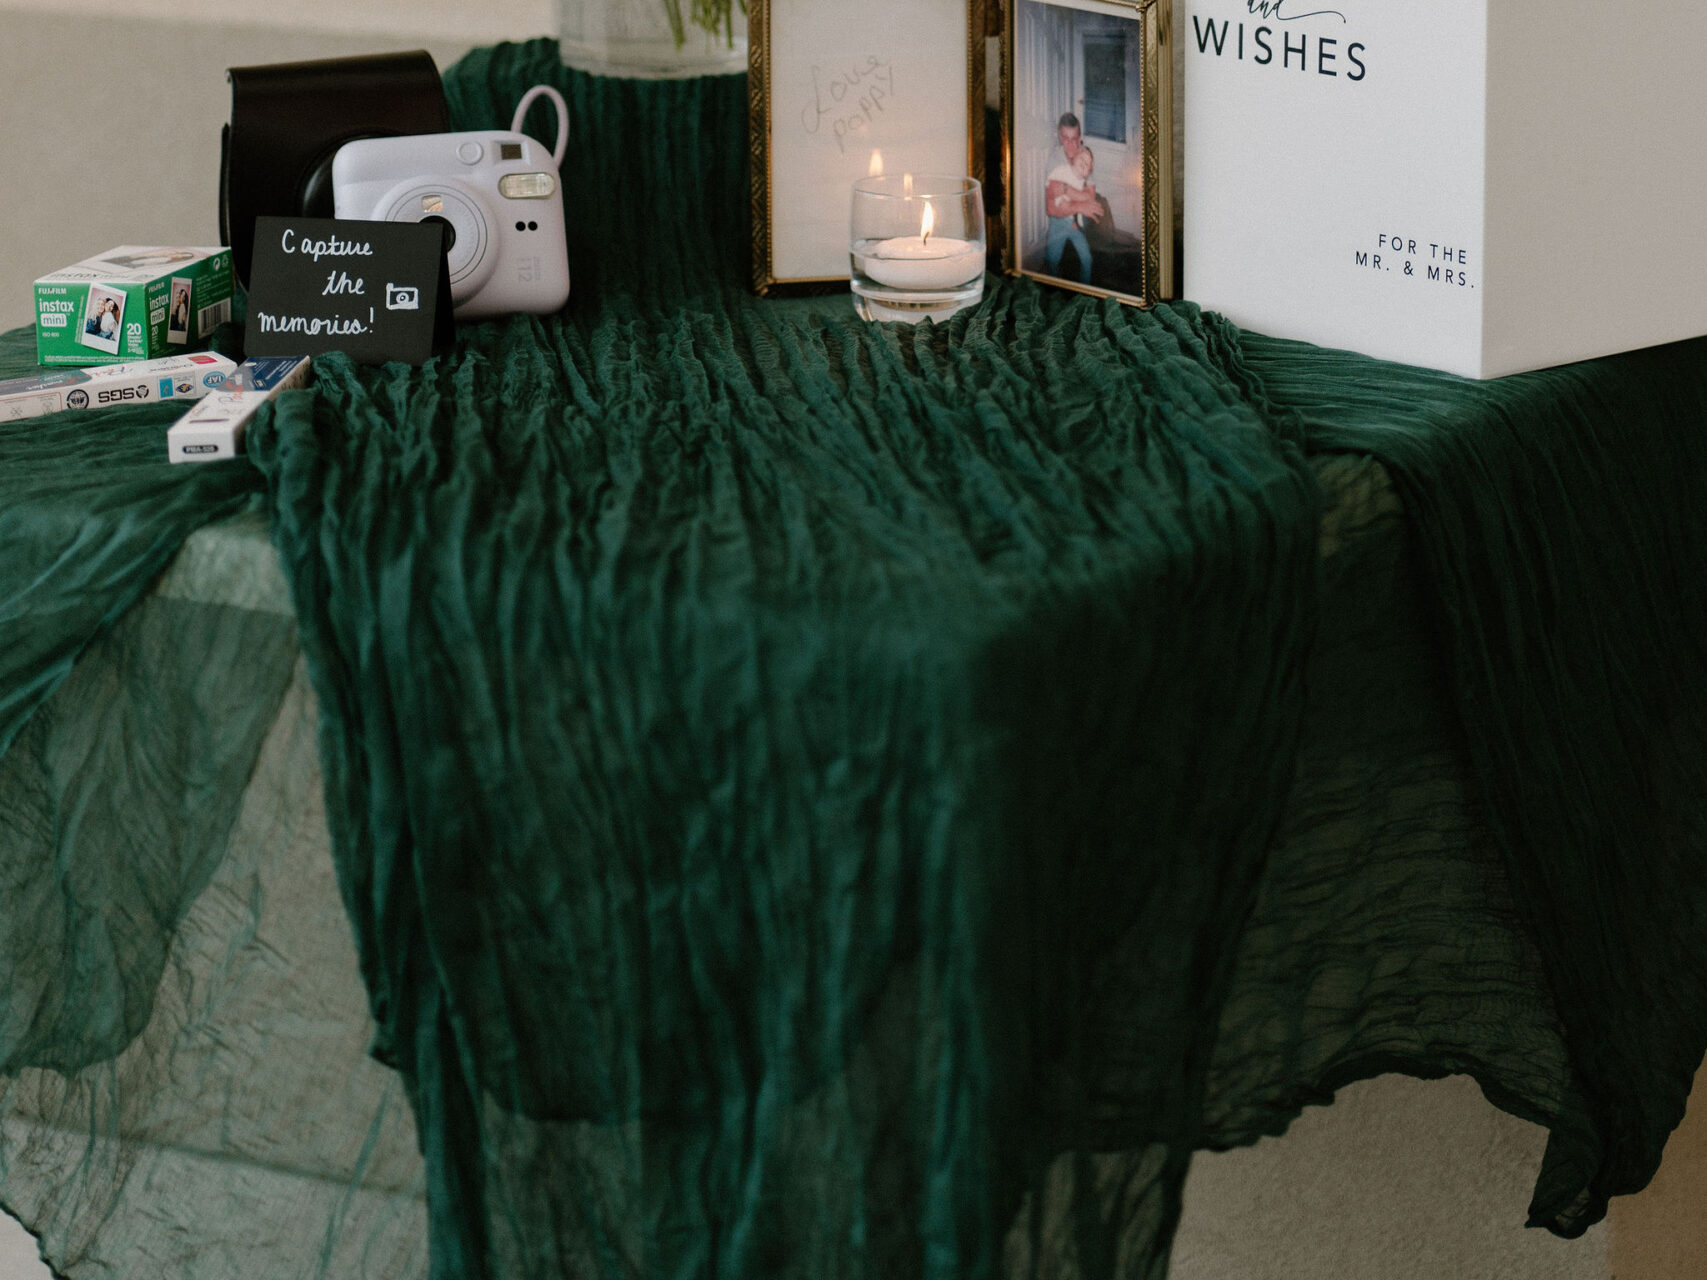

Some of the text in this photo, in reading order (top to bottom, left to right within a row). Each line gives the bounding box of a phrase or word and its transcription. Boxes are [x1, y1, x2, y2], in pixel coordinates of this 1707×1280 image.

[1193, 15, 1366, 81] WISHES
[281, 228, 373, 262] Capture
[1378, 233, 1467, 264] FOR THE
[1355, 251, 1474, 288] MR. & MRS.
[38, 287, 67, 295] FUJIFILM
[321, 270, 365, 296] the
[39, 298, 74, 312] instax
[149, 293, 169, 311] instax
[43, 315, 65, 325] mini
[126, 323, 141, 335] 20
[257, 307, 375, 335] memories!
[98, 387, 135, 403] SGS
